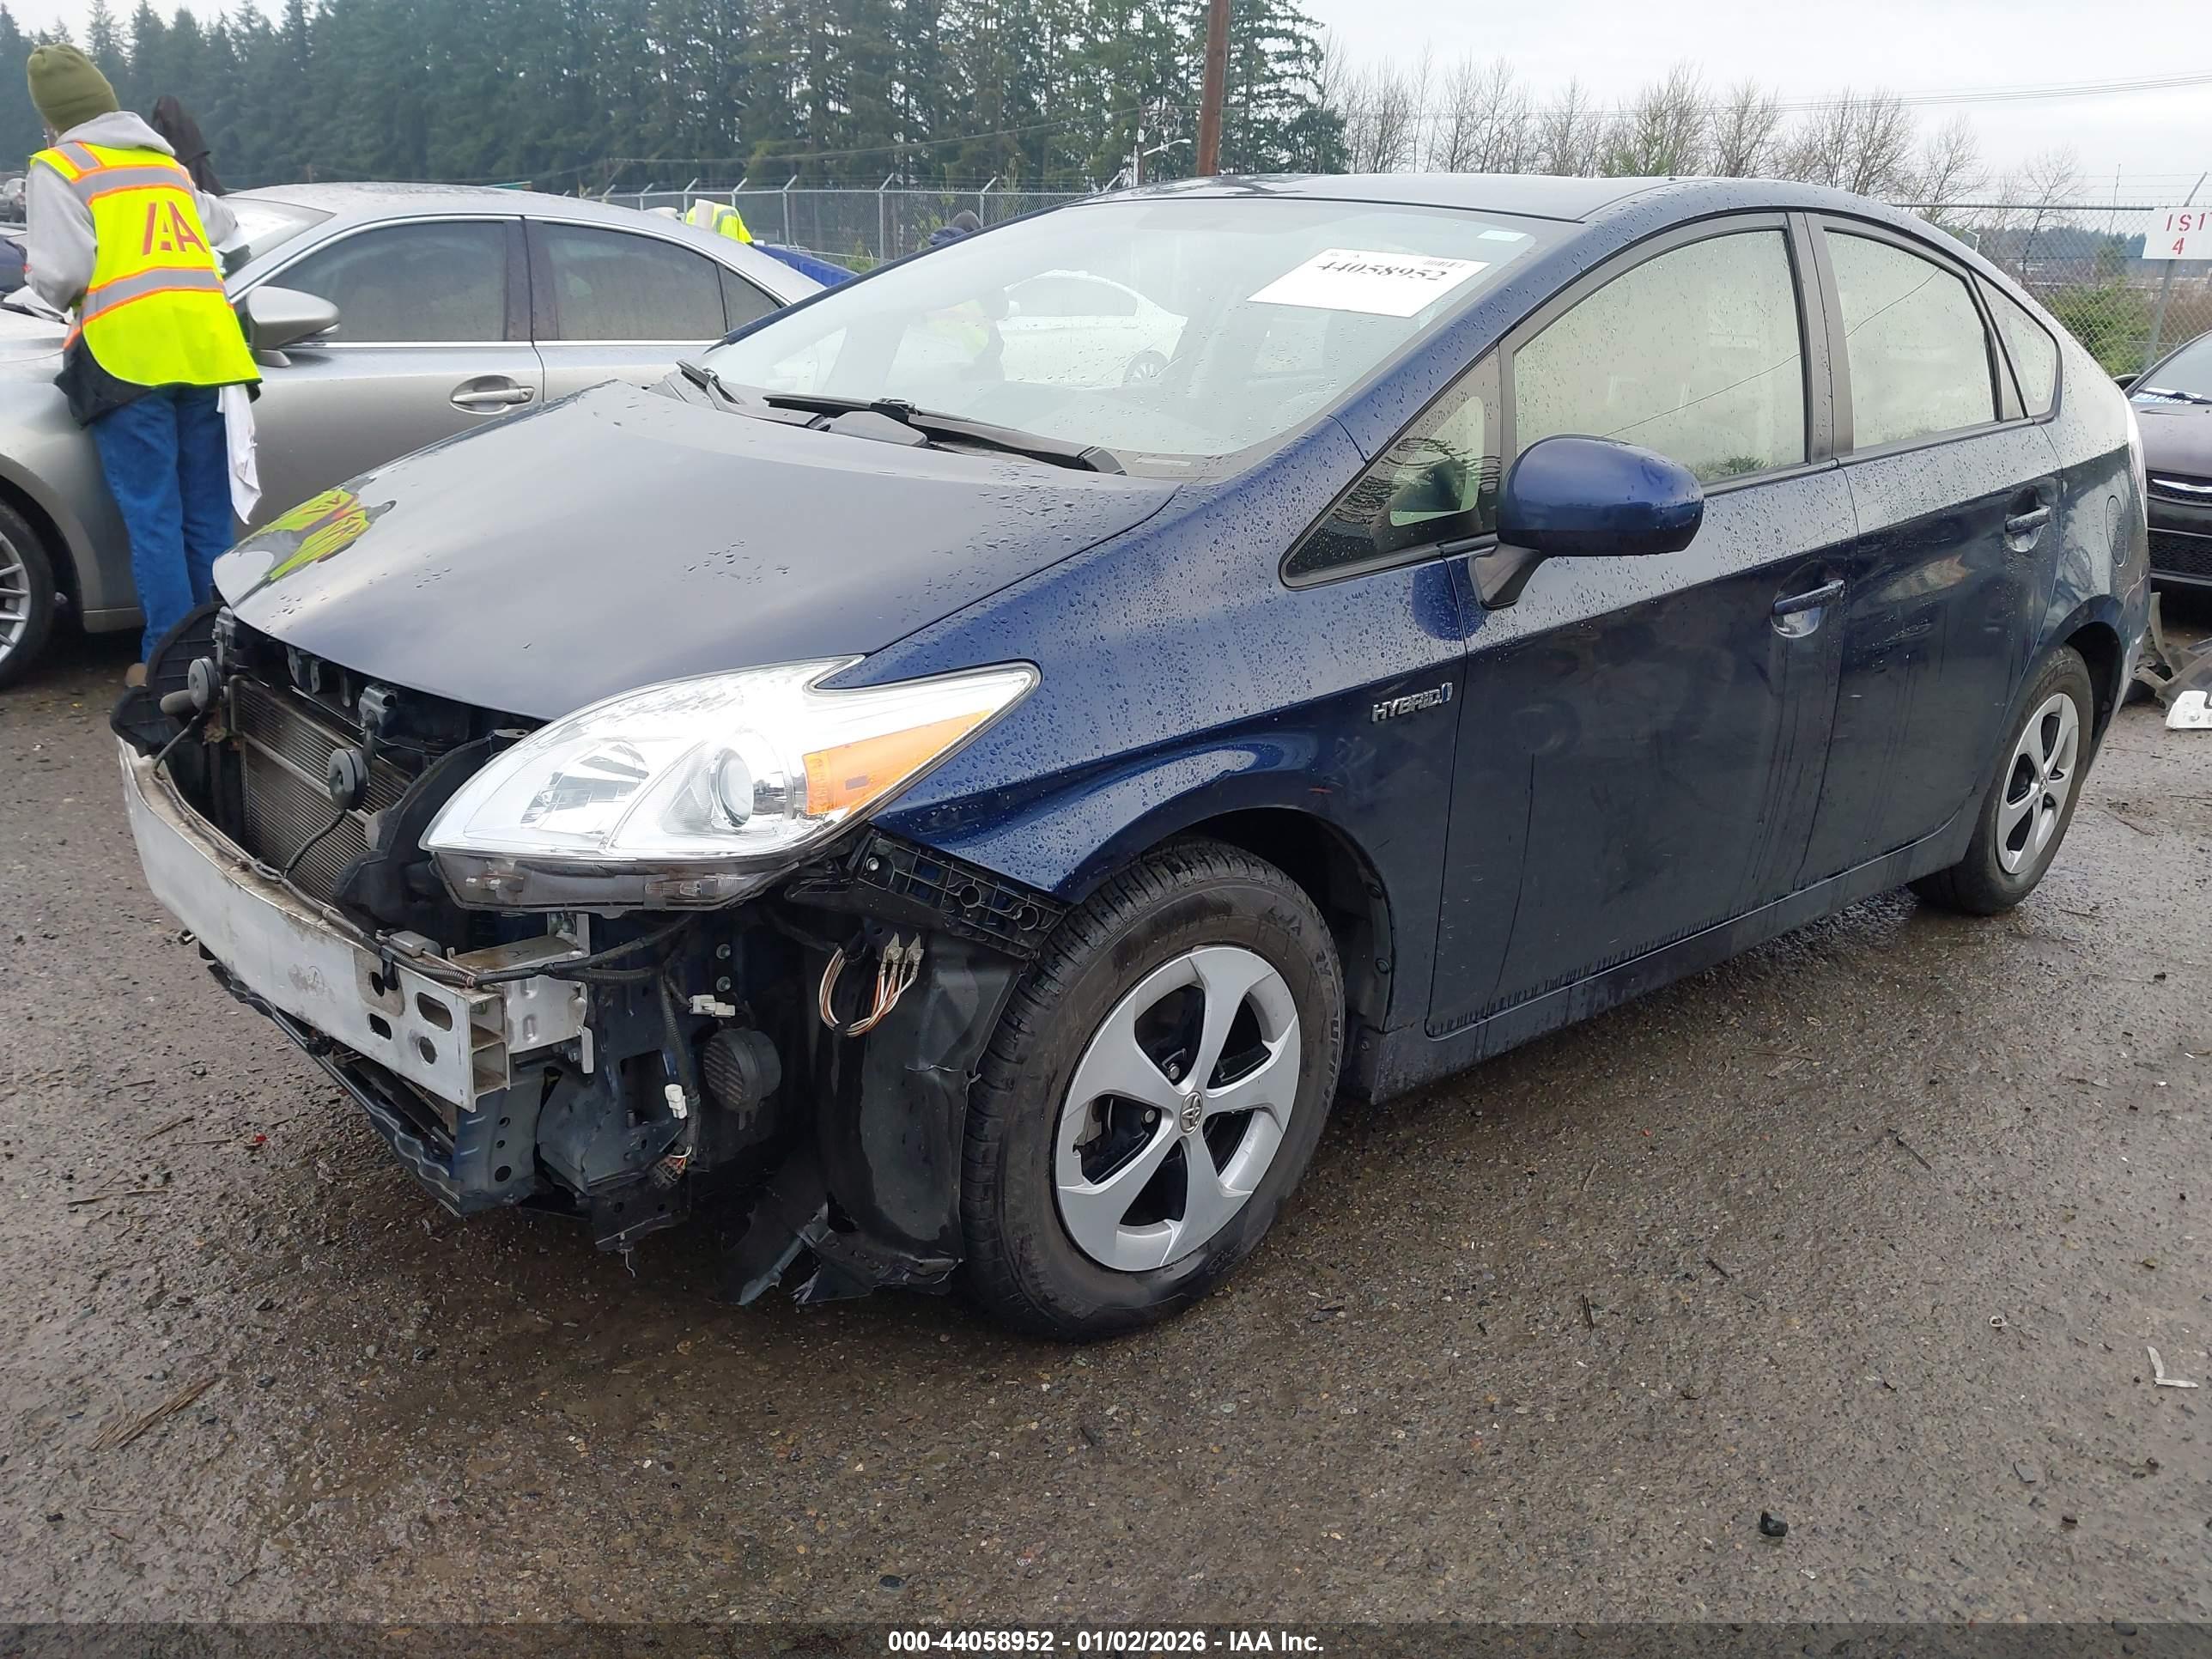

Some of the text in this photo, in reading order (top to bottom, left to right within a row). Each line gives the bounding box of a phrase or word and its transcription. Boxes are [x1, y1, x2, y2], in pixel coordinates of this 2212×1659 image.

[142, 201, 206, 256] IAA
[2172, 237, 2185, 255] 4
[1372, 688, 1442, 722] HYBRID
